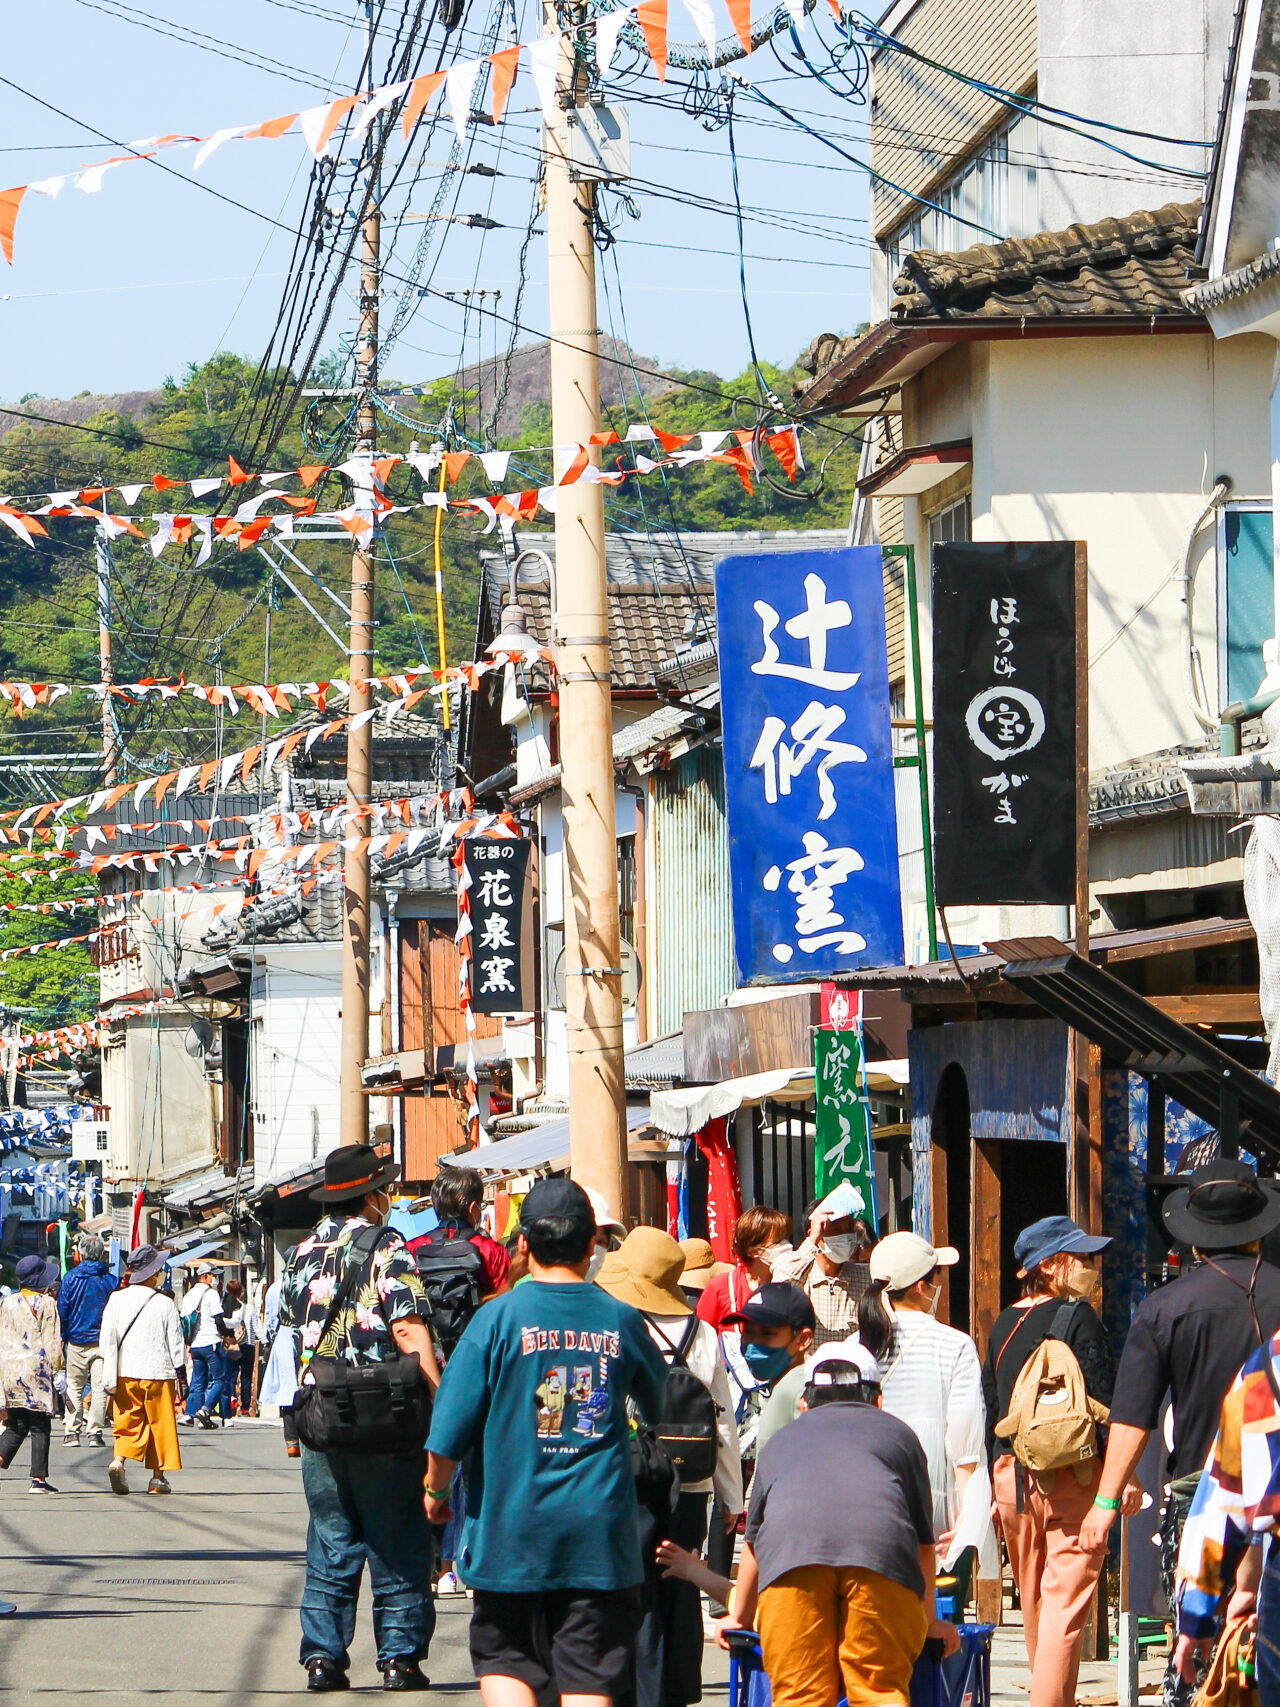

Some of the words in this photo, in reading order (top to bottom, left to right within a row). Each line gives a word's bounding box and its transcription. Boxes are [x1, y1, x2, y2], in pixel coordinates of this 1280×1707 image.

[749, 572, 868, 963] 辻修窯
[981, 772, 1029, 825] がま
[473, 846, 514, 861] 花器の
[476, 869, 516, 993] 花泉窯
[822, 1036, 863, 1193] 窯元
[522, 1328, 560, 1356] BEN
[564, 1328, 620, 1358] DAVIS
